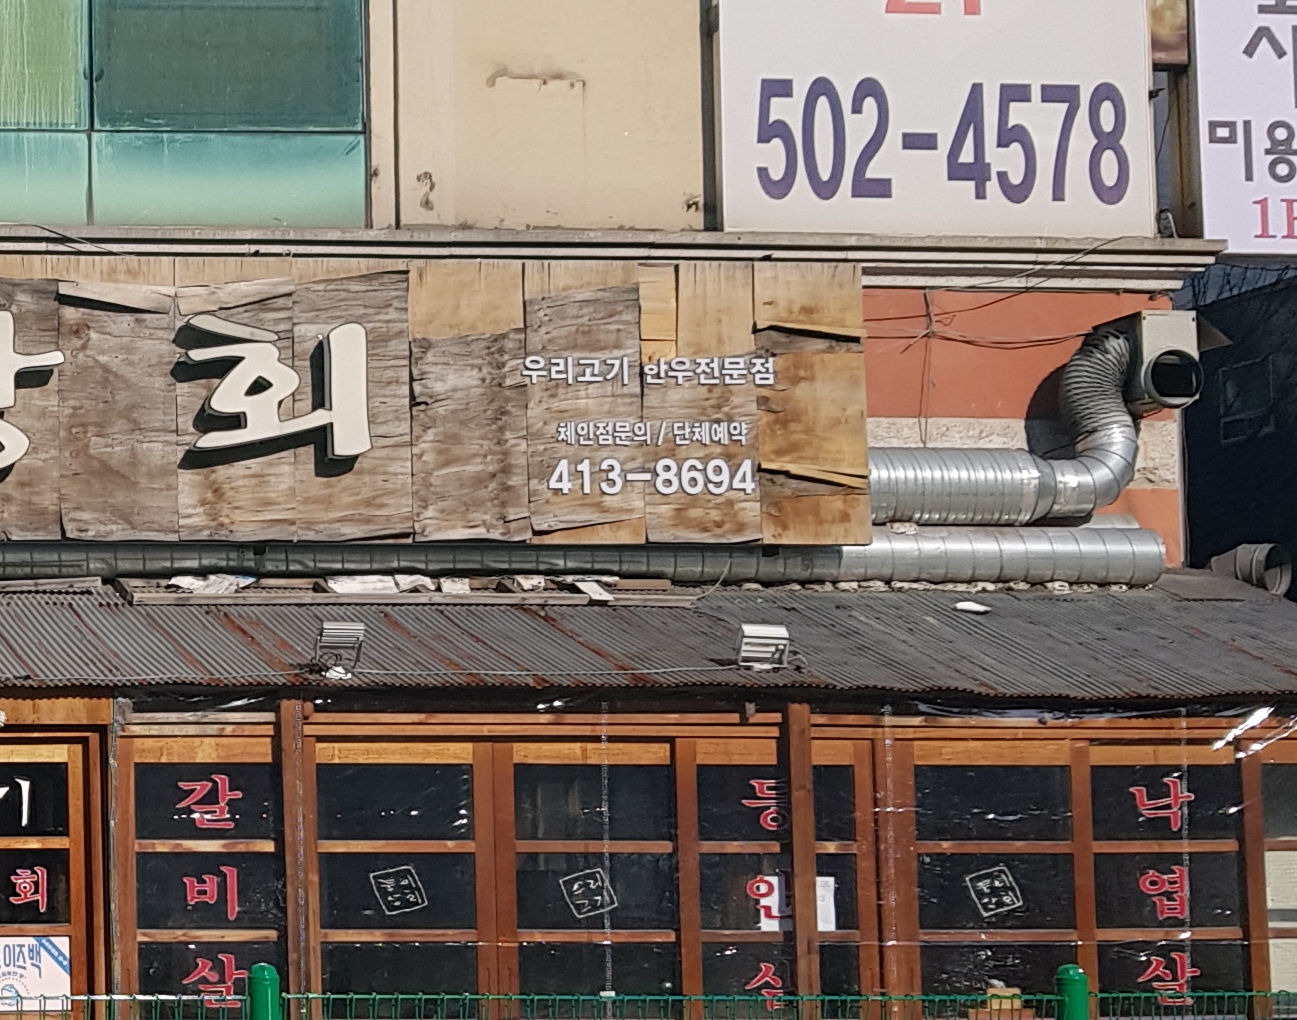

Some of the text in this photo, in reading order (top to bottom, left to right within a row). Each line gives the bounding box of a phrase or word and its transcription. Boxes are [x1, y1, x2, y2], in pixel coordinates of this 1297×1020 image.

[756, 76, 1130, 205] 502-4578
[521, 355, 630, 385] 우리고기
[557, 421, 652, 445] 체인점문의
[672, 421, 749, 445] 단체예약
[548, 457, 756, 496] 413-8694
